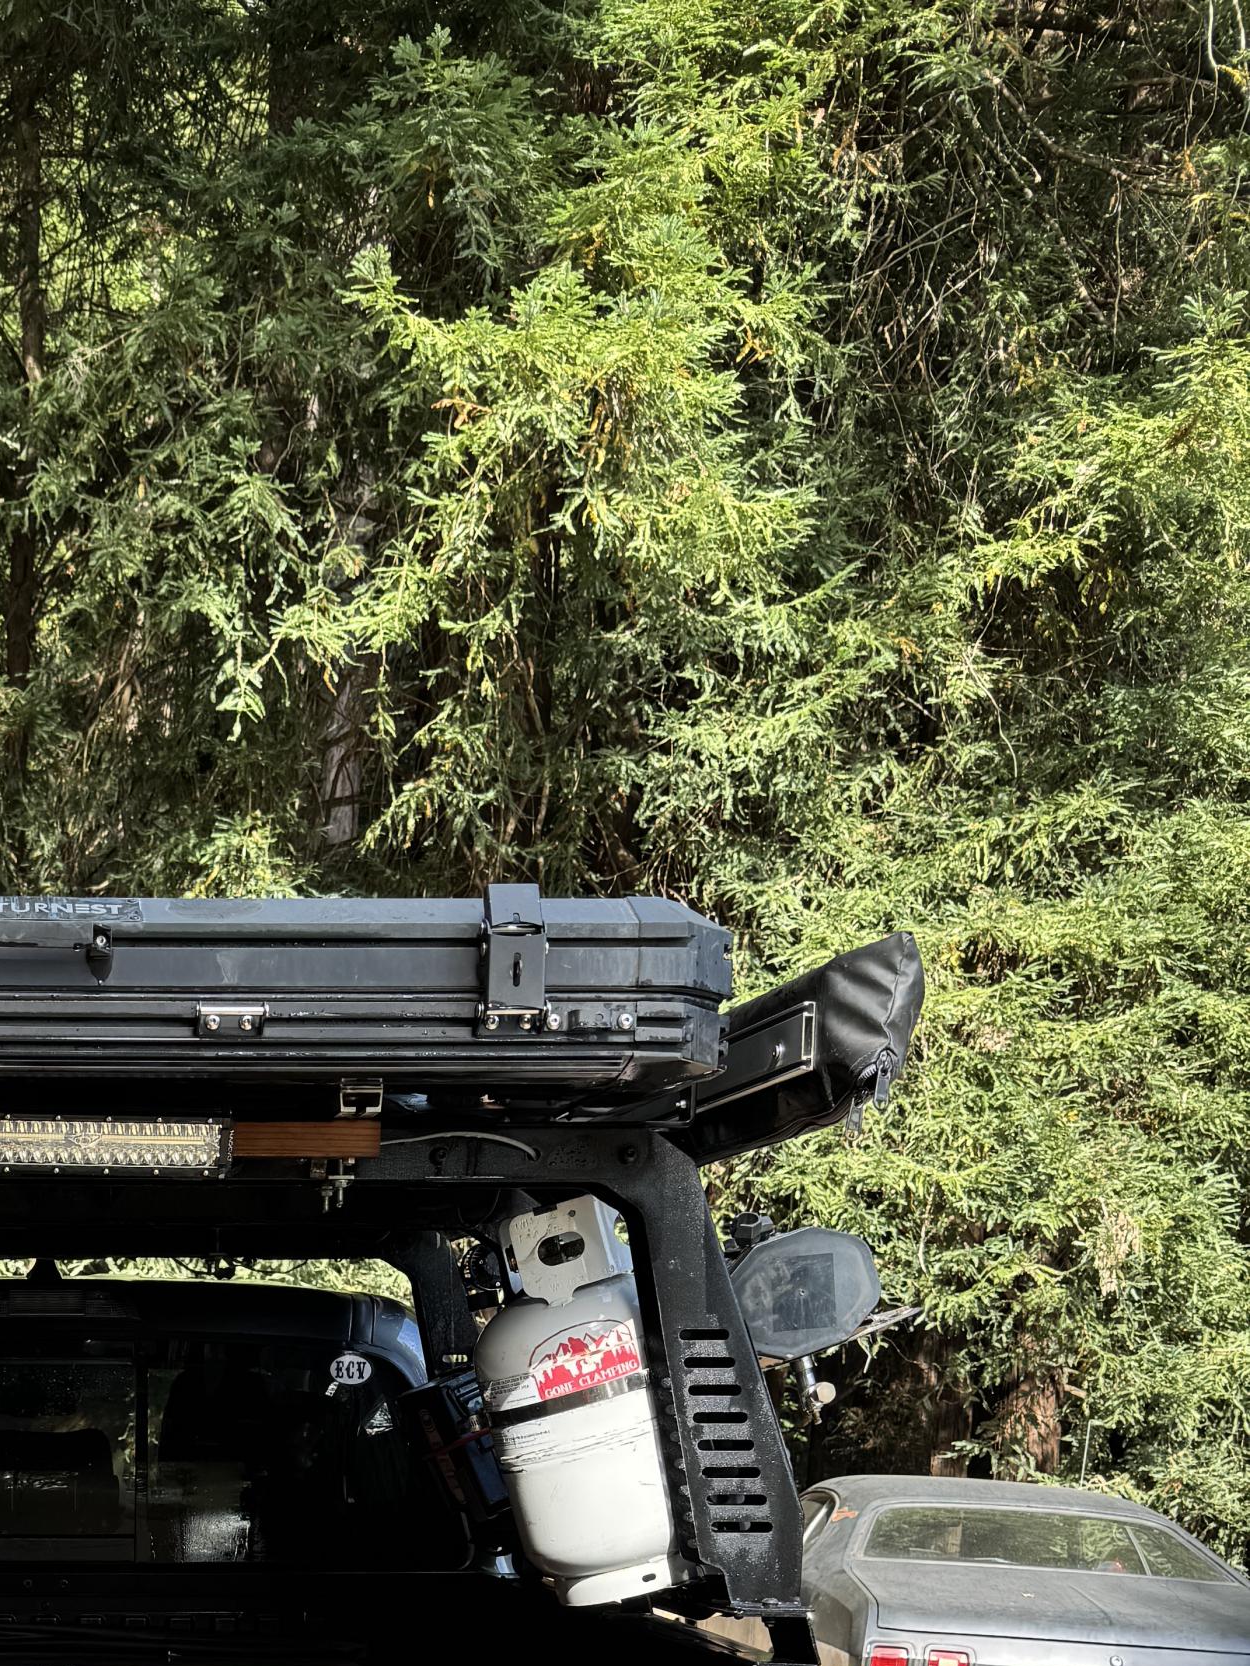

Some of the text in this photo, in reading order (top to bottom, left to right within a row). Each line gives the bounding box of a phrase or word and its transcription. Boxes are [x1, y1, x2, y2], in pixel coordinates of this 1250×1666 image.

[334, 1360, 367, 1380] ECV
[544, 1381, 576, 1399] GONE
[579, 1359, 638, 1387] CLAMPING
